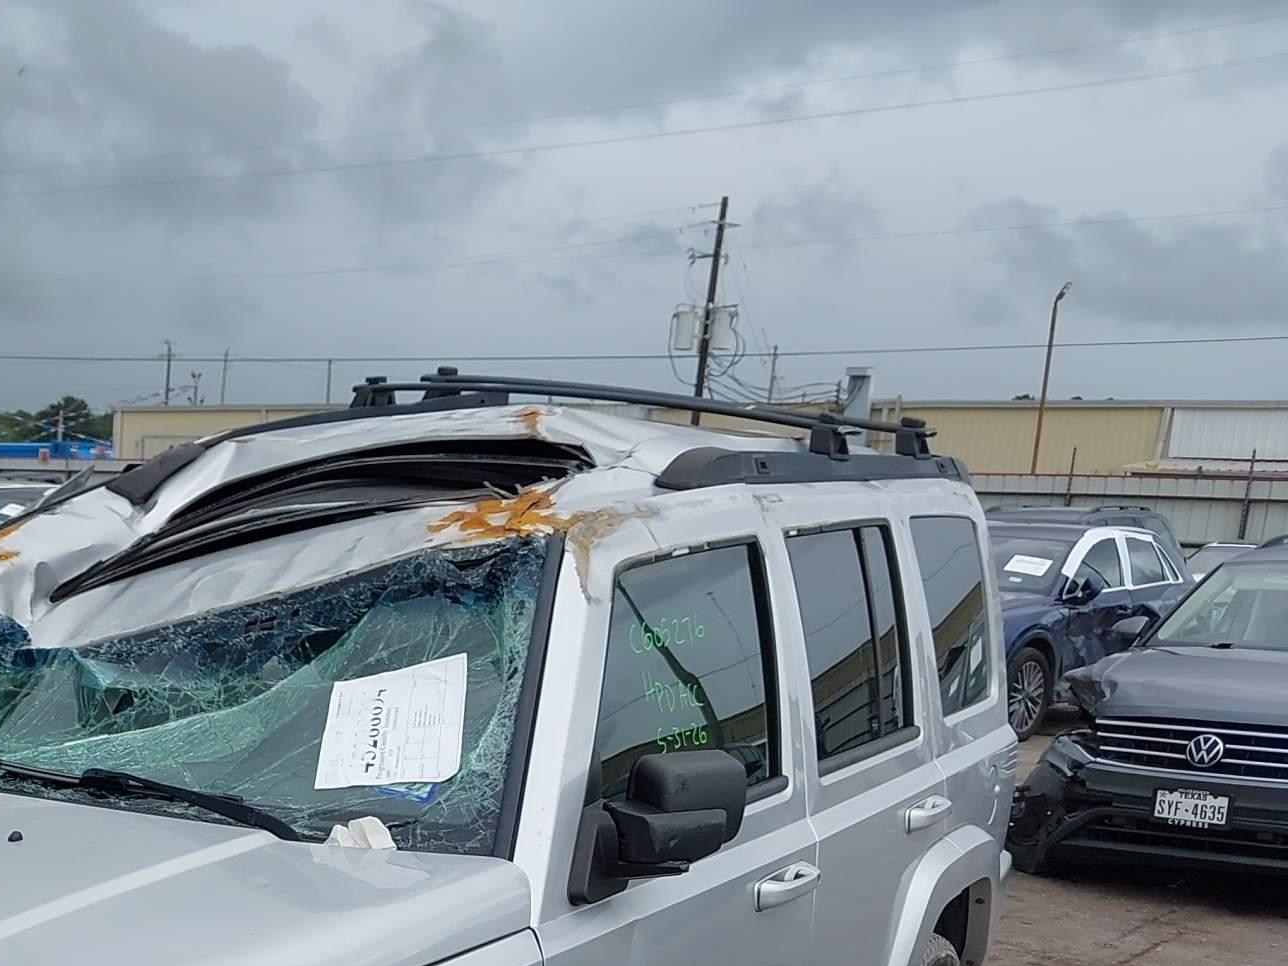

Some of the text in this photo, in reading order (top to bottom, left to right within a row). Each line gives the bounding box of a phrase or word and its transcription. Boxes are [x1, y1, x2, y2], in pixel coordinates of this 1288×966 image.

[641, 670, 705, 713] HPD ACC
[656, 722, 708, 755] 5-31-26
[1179, 791, 1208, 801] TEXAS
[1167, 818, 1209, 829] CYPRESS
